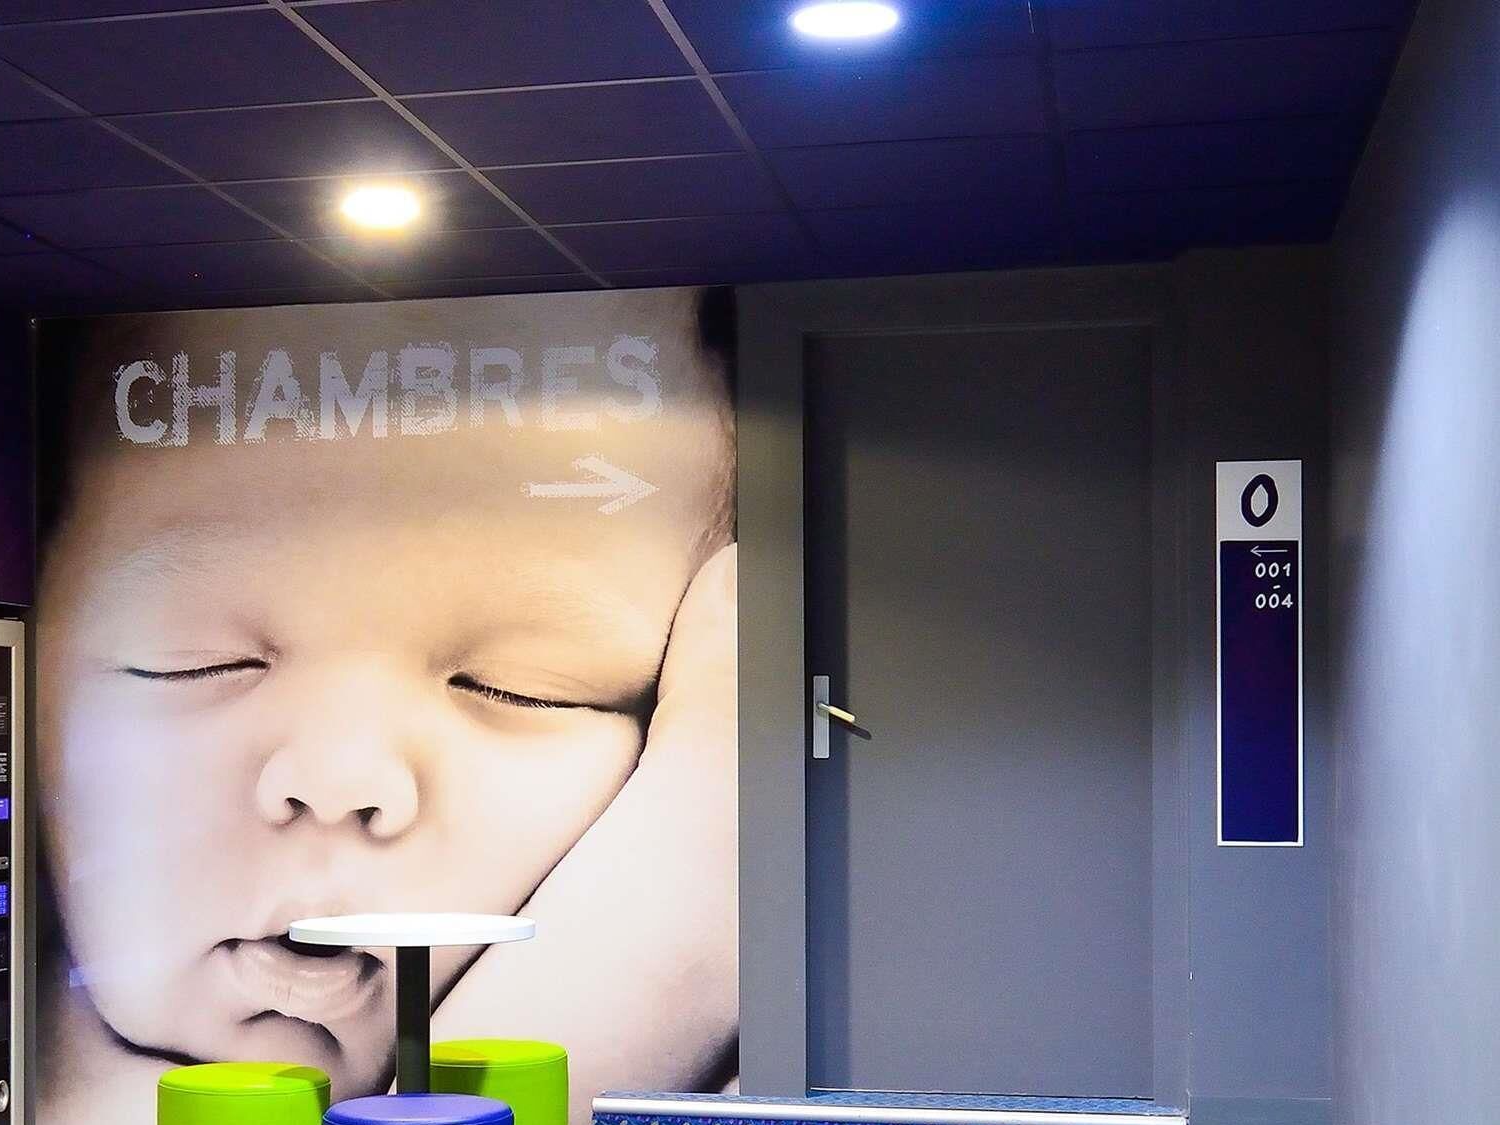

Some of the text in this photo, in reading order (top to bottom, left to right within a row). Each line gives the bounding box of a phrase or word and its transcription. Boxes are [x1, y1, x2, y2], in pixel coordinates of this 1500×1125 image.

[114, 335, 663, 448] CHAMBRES
[1241, 473, 1279, 527] 0
[1255, 562, 1291, 578] 001
[1255, 593, 1293, 609] 004
